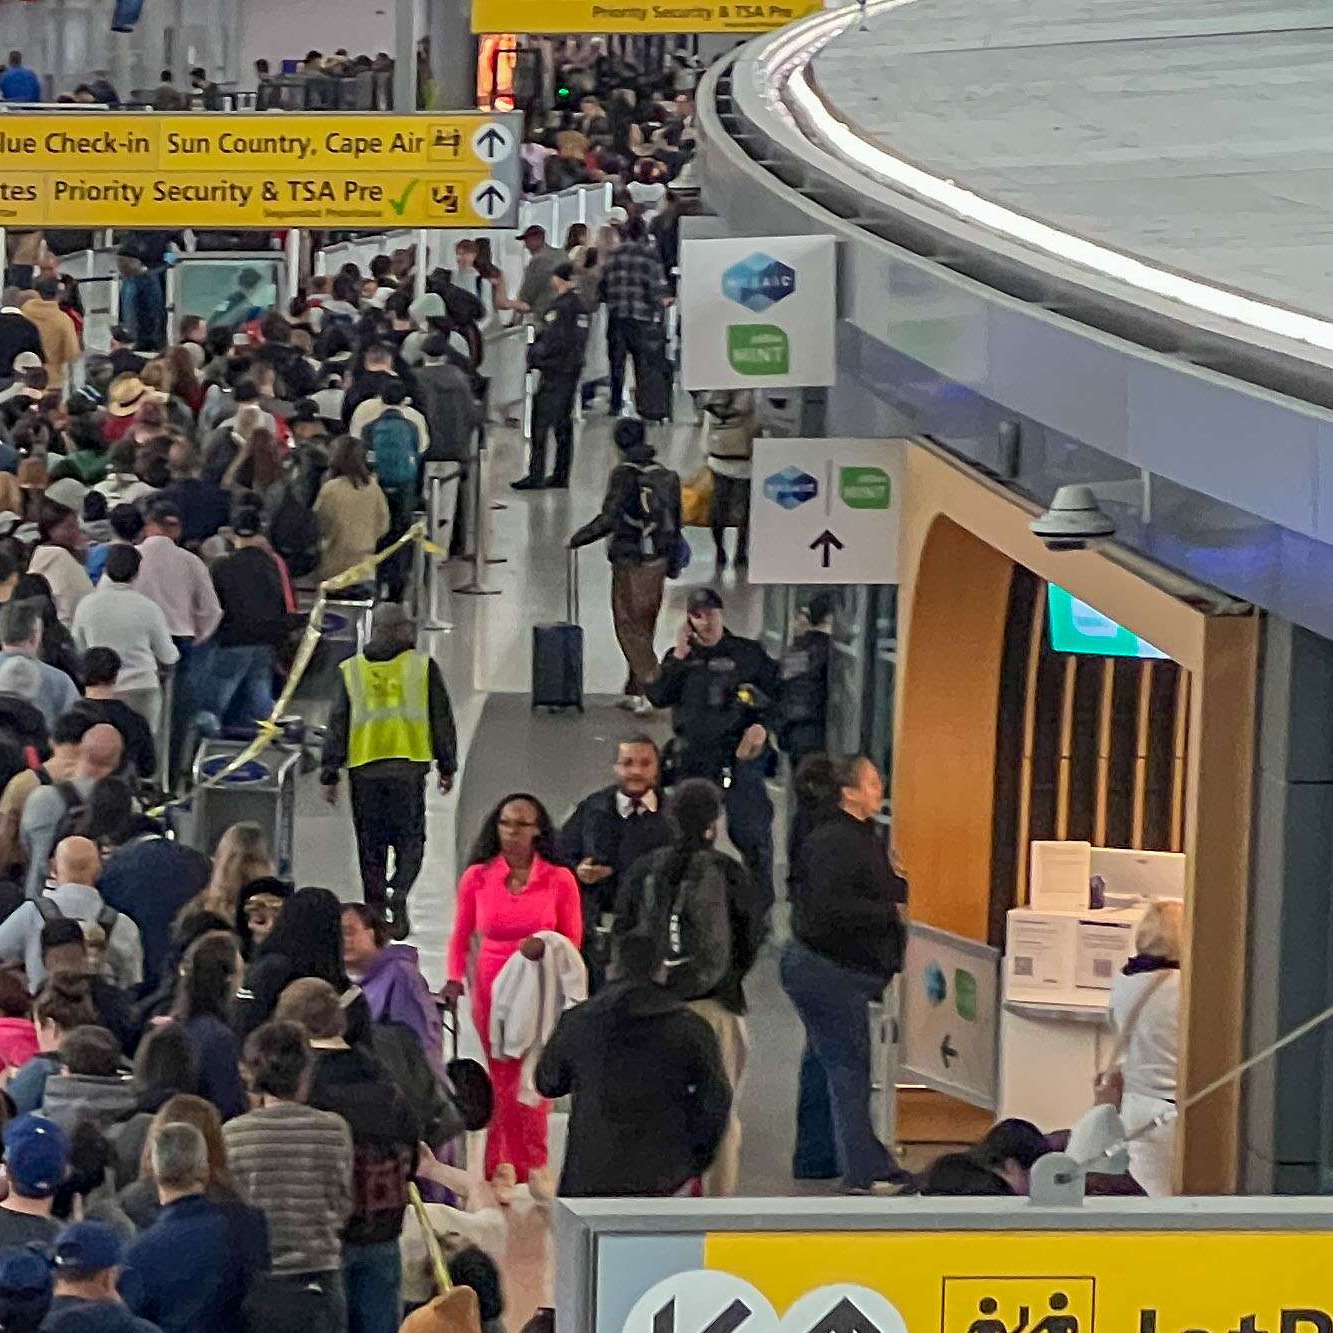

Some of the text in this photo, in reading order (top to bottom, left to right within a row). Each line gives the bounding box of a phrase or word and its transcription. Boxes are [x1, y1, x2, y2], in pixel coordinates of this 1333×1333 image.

[44, 131, 150, 154] Check-in
[167, 132, 210, 154] Sun
[325, 132, 382, 159] Cape
[389, 132, 425, 154] Air
[54, 179, 145, 207] Priority
[152, 179, 253, 207] Security
[261, 181, 279, 201] &
[287, 180, 336, 202] TSA
[344, 180, 383, 201] Pre
